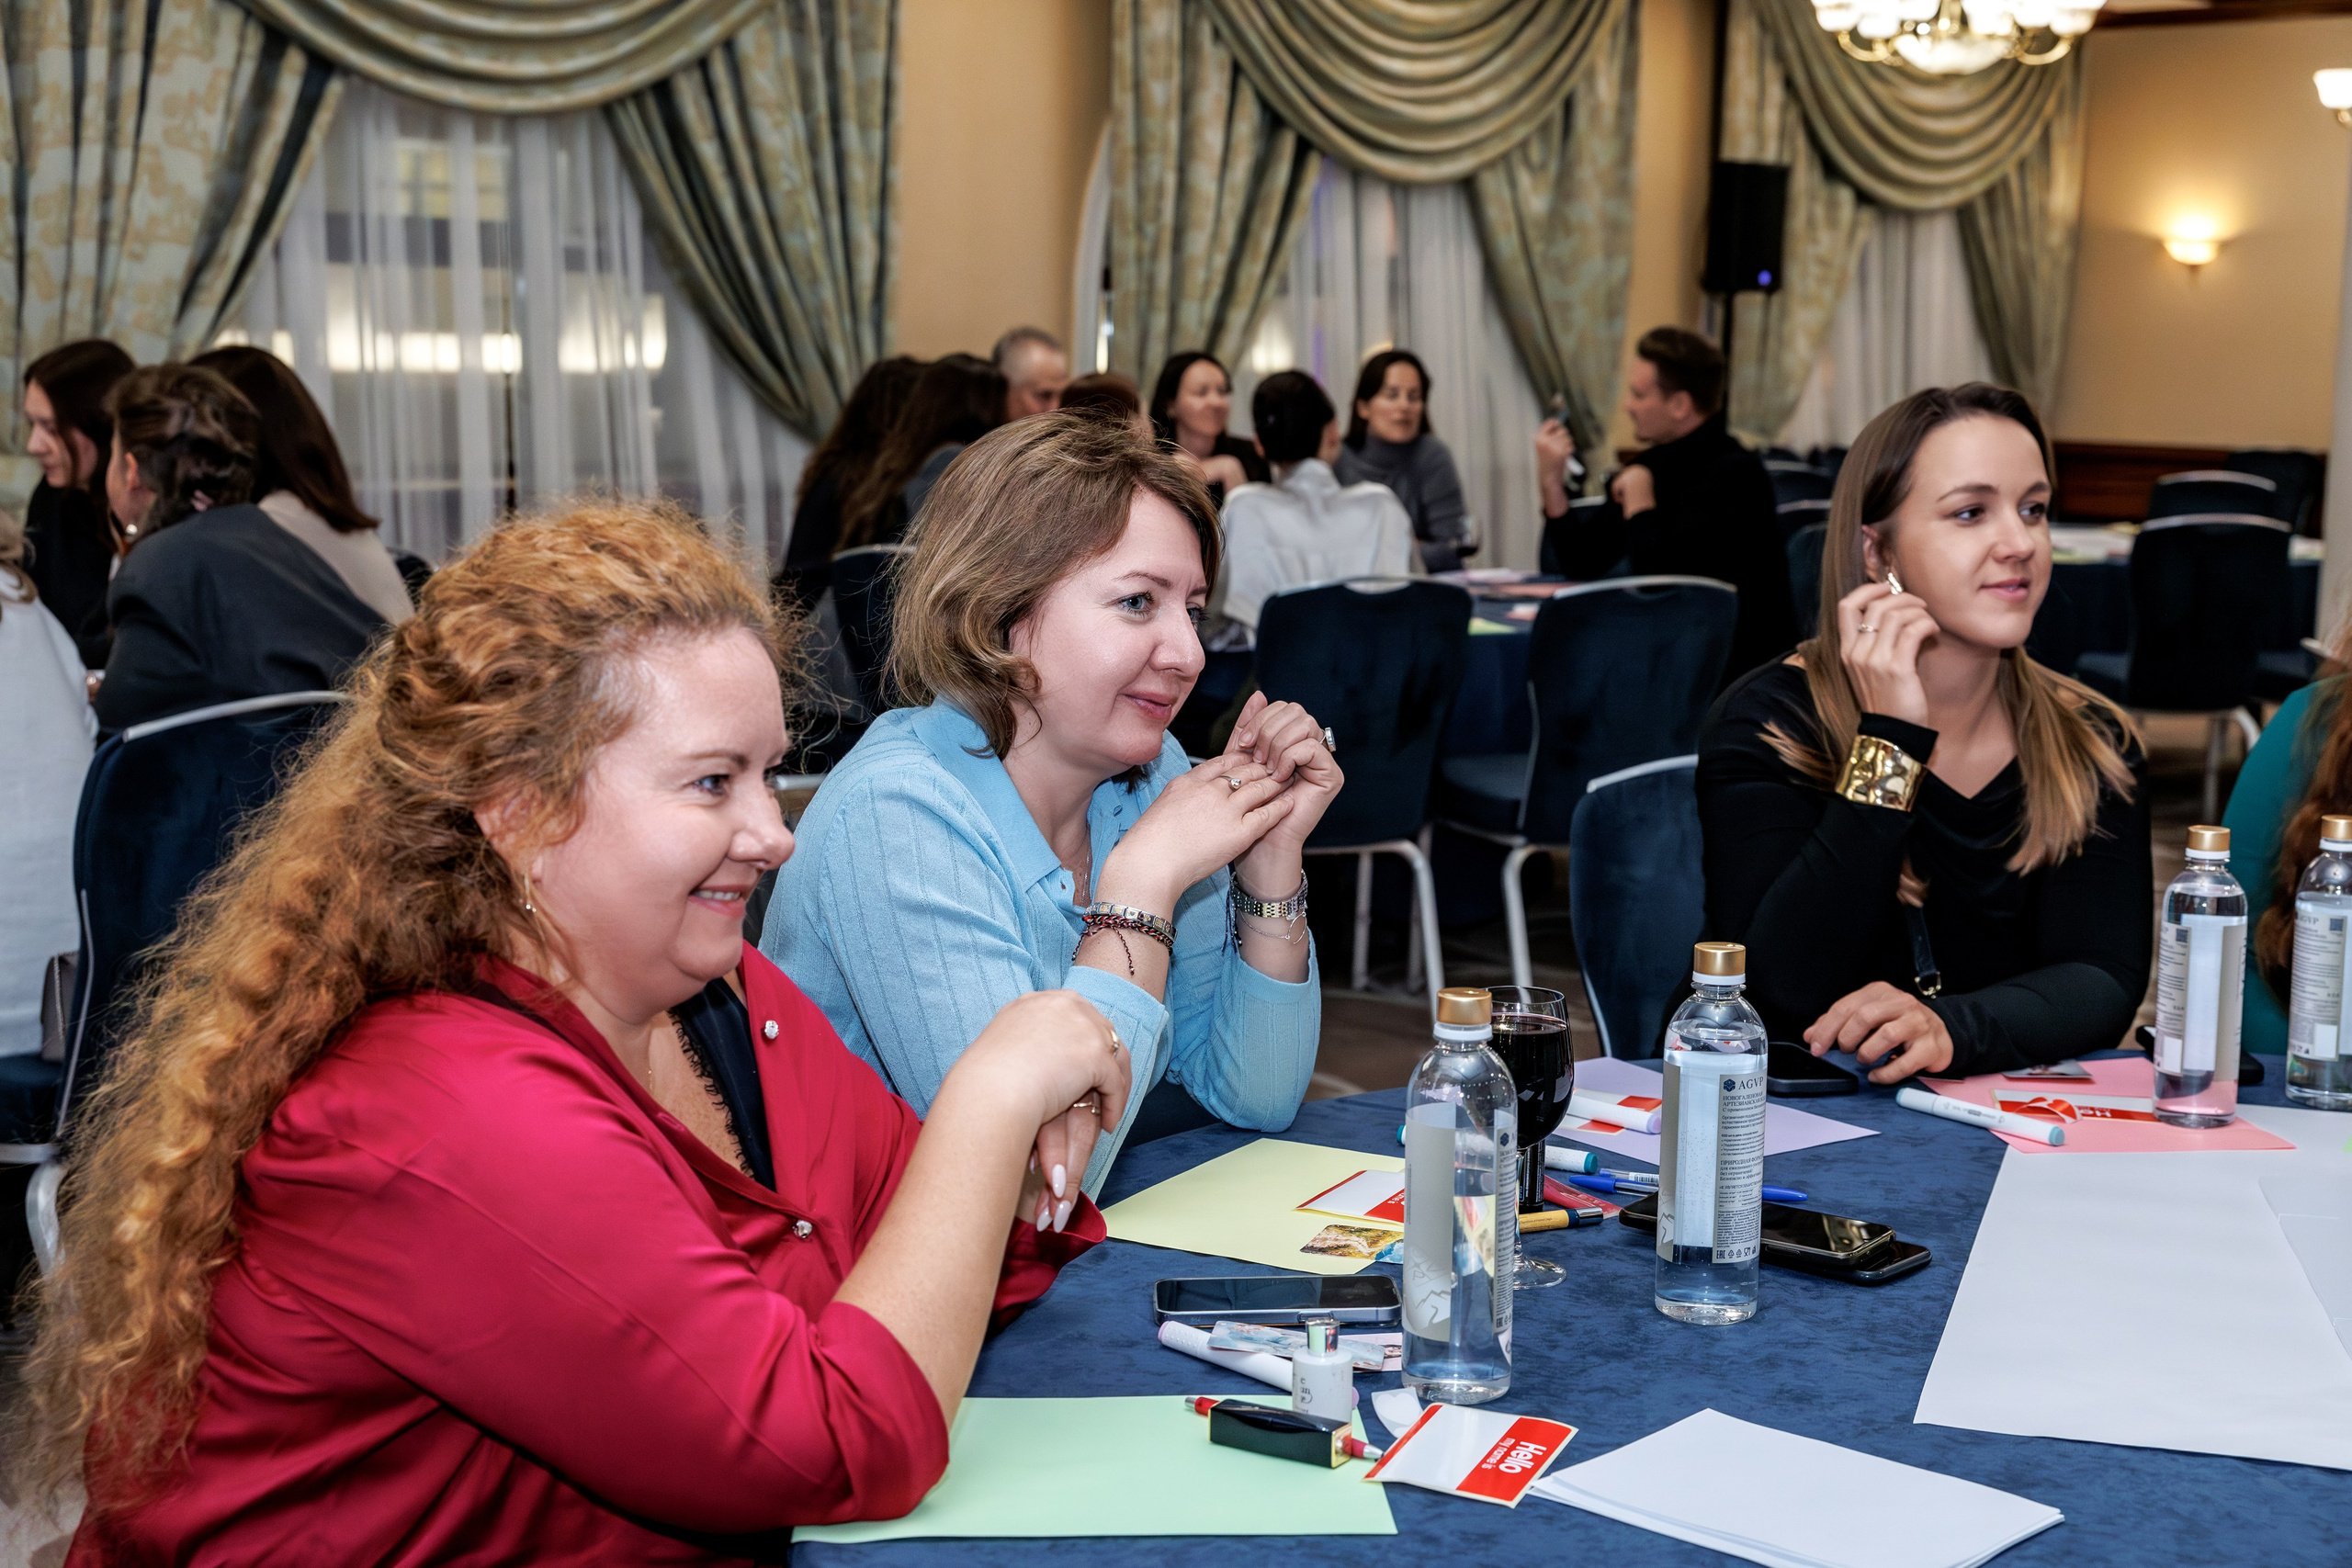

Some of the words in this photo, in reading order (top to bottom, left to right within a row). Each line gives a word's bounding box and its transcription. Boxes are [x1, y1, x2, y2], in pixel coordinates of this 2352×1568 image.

[1738, 1076, 1764, 1090] AGVP
[1498, 1437, 1516, 1448] my
[1487, 1446, 1508, 1464] name
[1498, 1440, 1547, 1473] Hello
